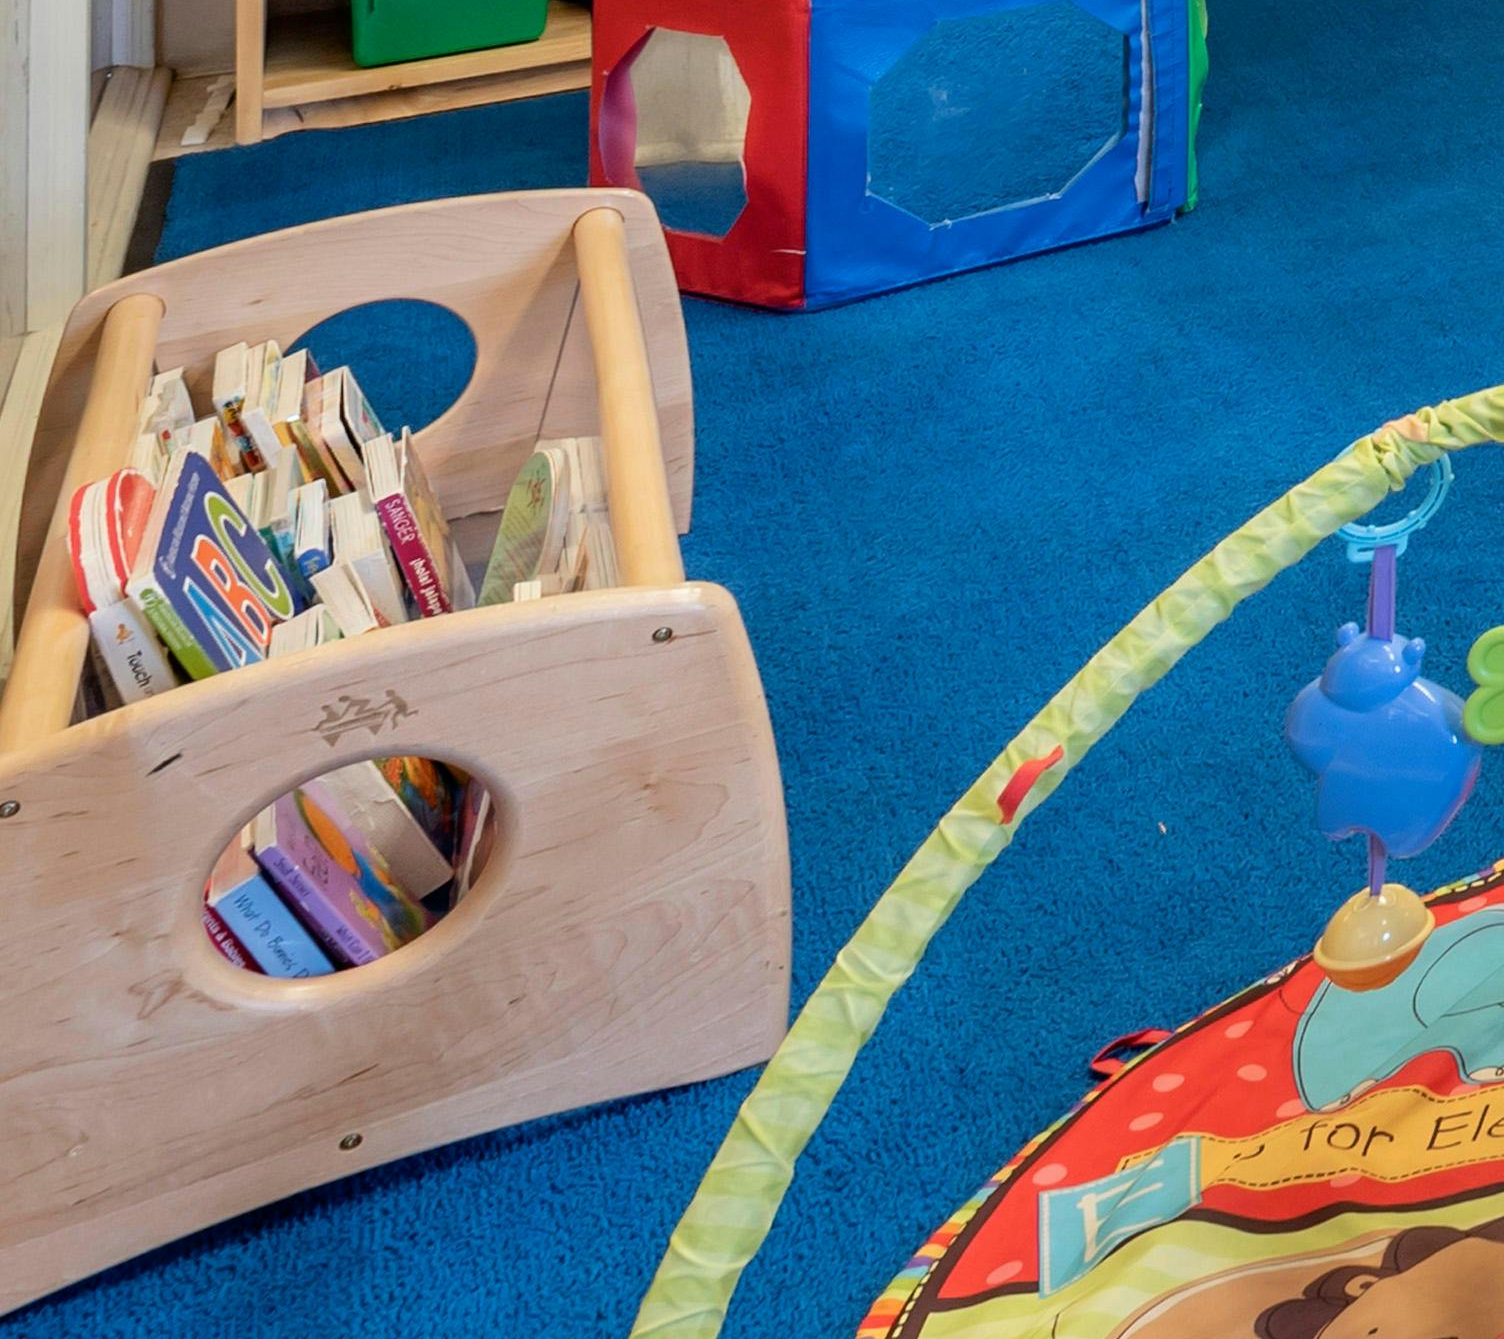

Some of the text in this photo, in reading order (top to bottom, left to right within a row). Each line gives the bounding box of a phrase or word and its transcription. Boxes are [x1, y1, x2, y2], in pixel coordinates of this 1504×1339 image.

[383, 499, 416, 543] SANGER
[182, 490, 295, 670] ABC
[127, 649, 153, 689] Touch
[234, 893, 261, 923] What
[255, 920, 272, 937] Do
[1299, 1120, 1396, 1158] for
